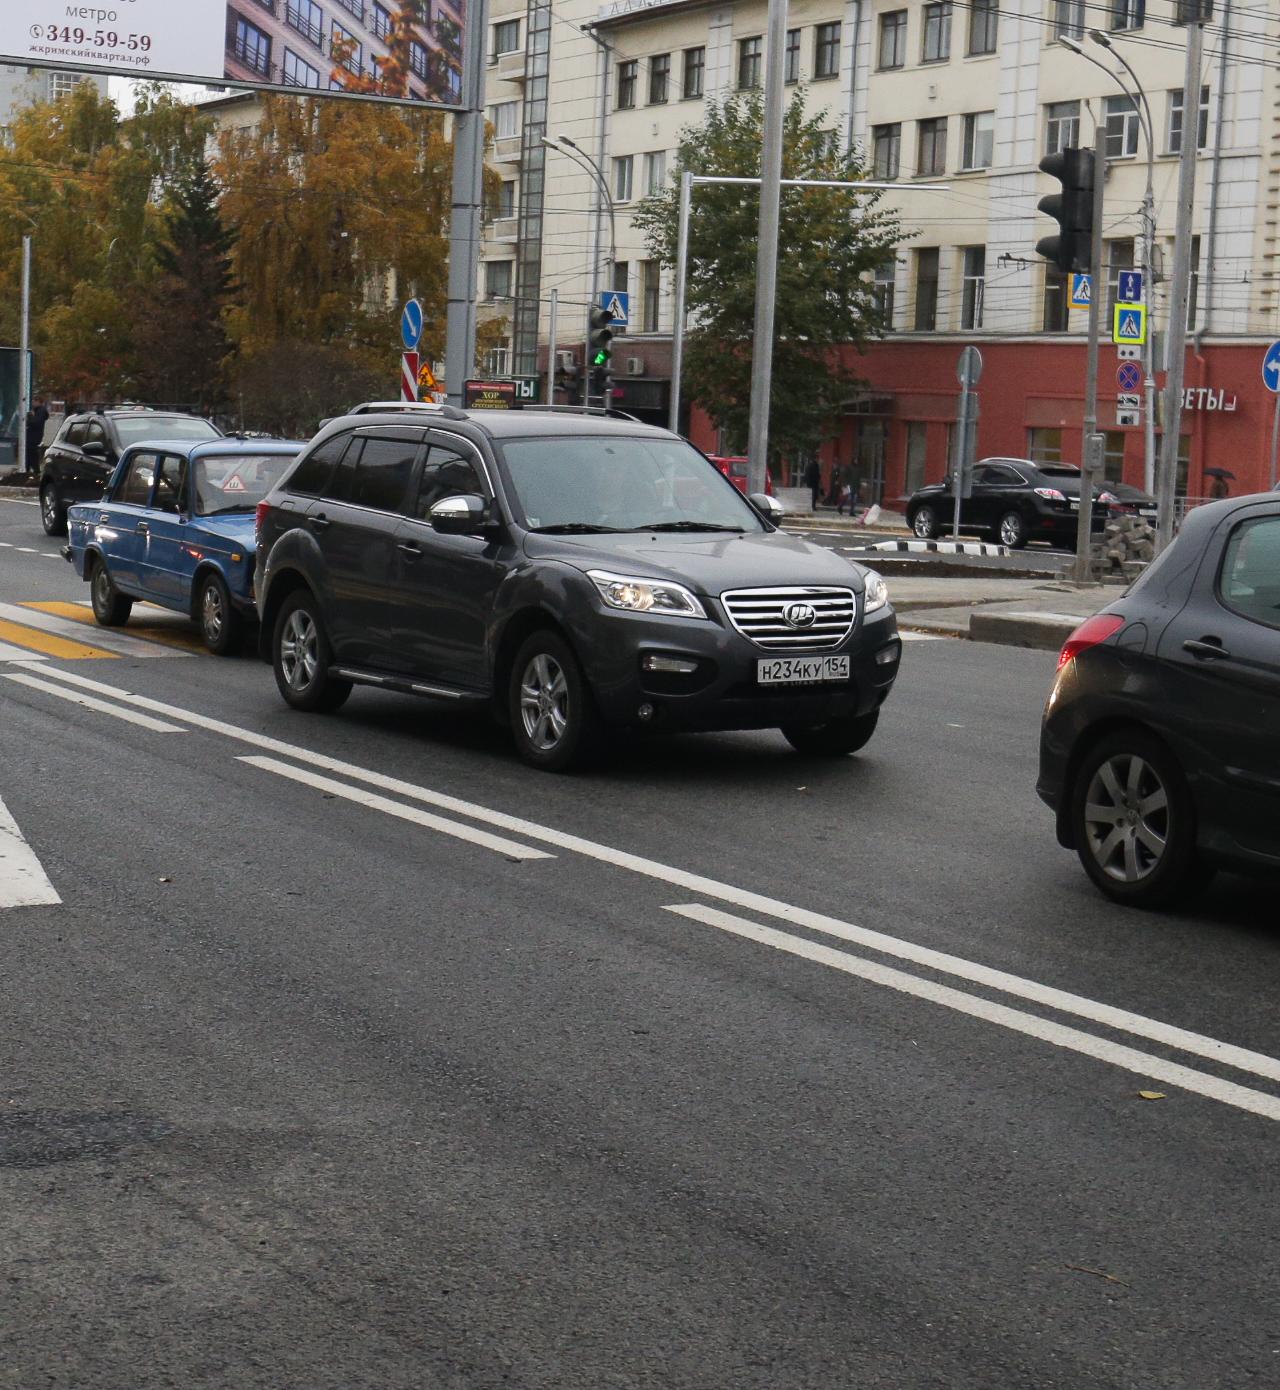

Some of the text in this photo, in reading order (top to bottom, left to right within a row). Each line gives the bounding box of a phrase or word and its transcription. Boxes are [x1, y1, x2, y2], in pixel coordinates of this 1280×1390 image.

[65, 6, 117, 24] метро
[47, 24, 151, 51] 349-59-59
[29, 45, 150, 66] жкримскийквартал.рф
[482, 391, 500, 399] ХОР
[762, 657, 847, 680] Н234КУ 154
